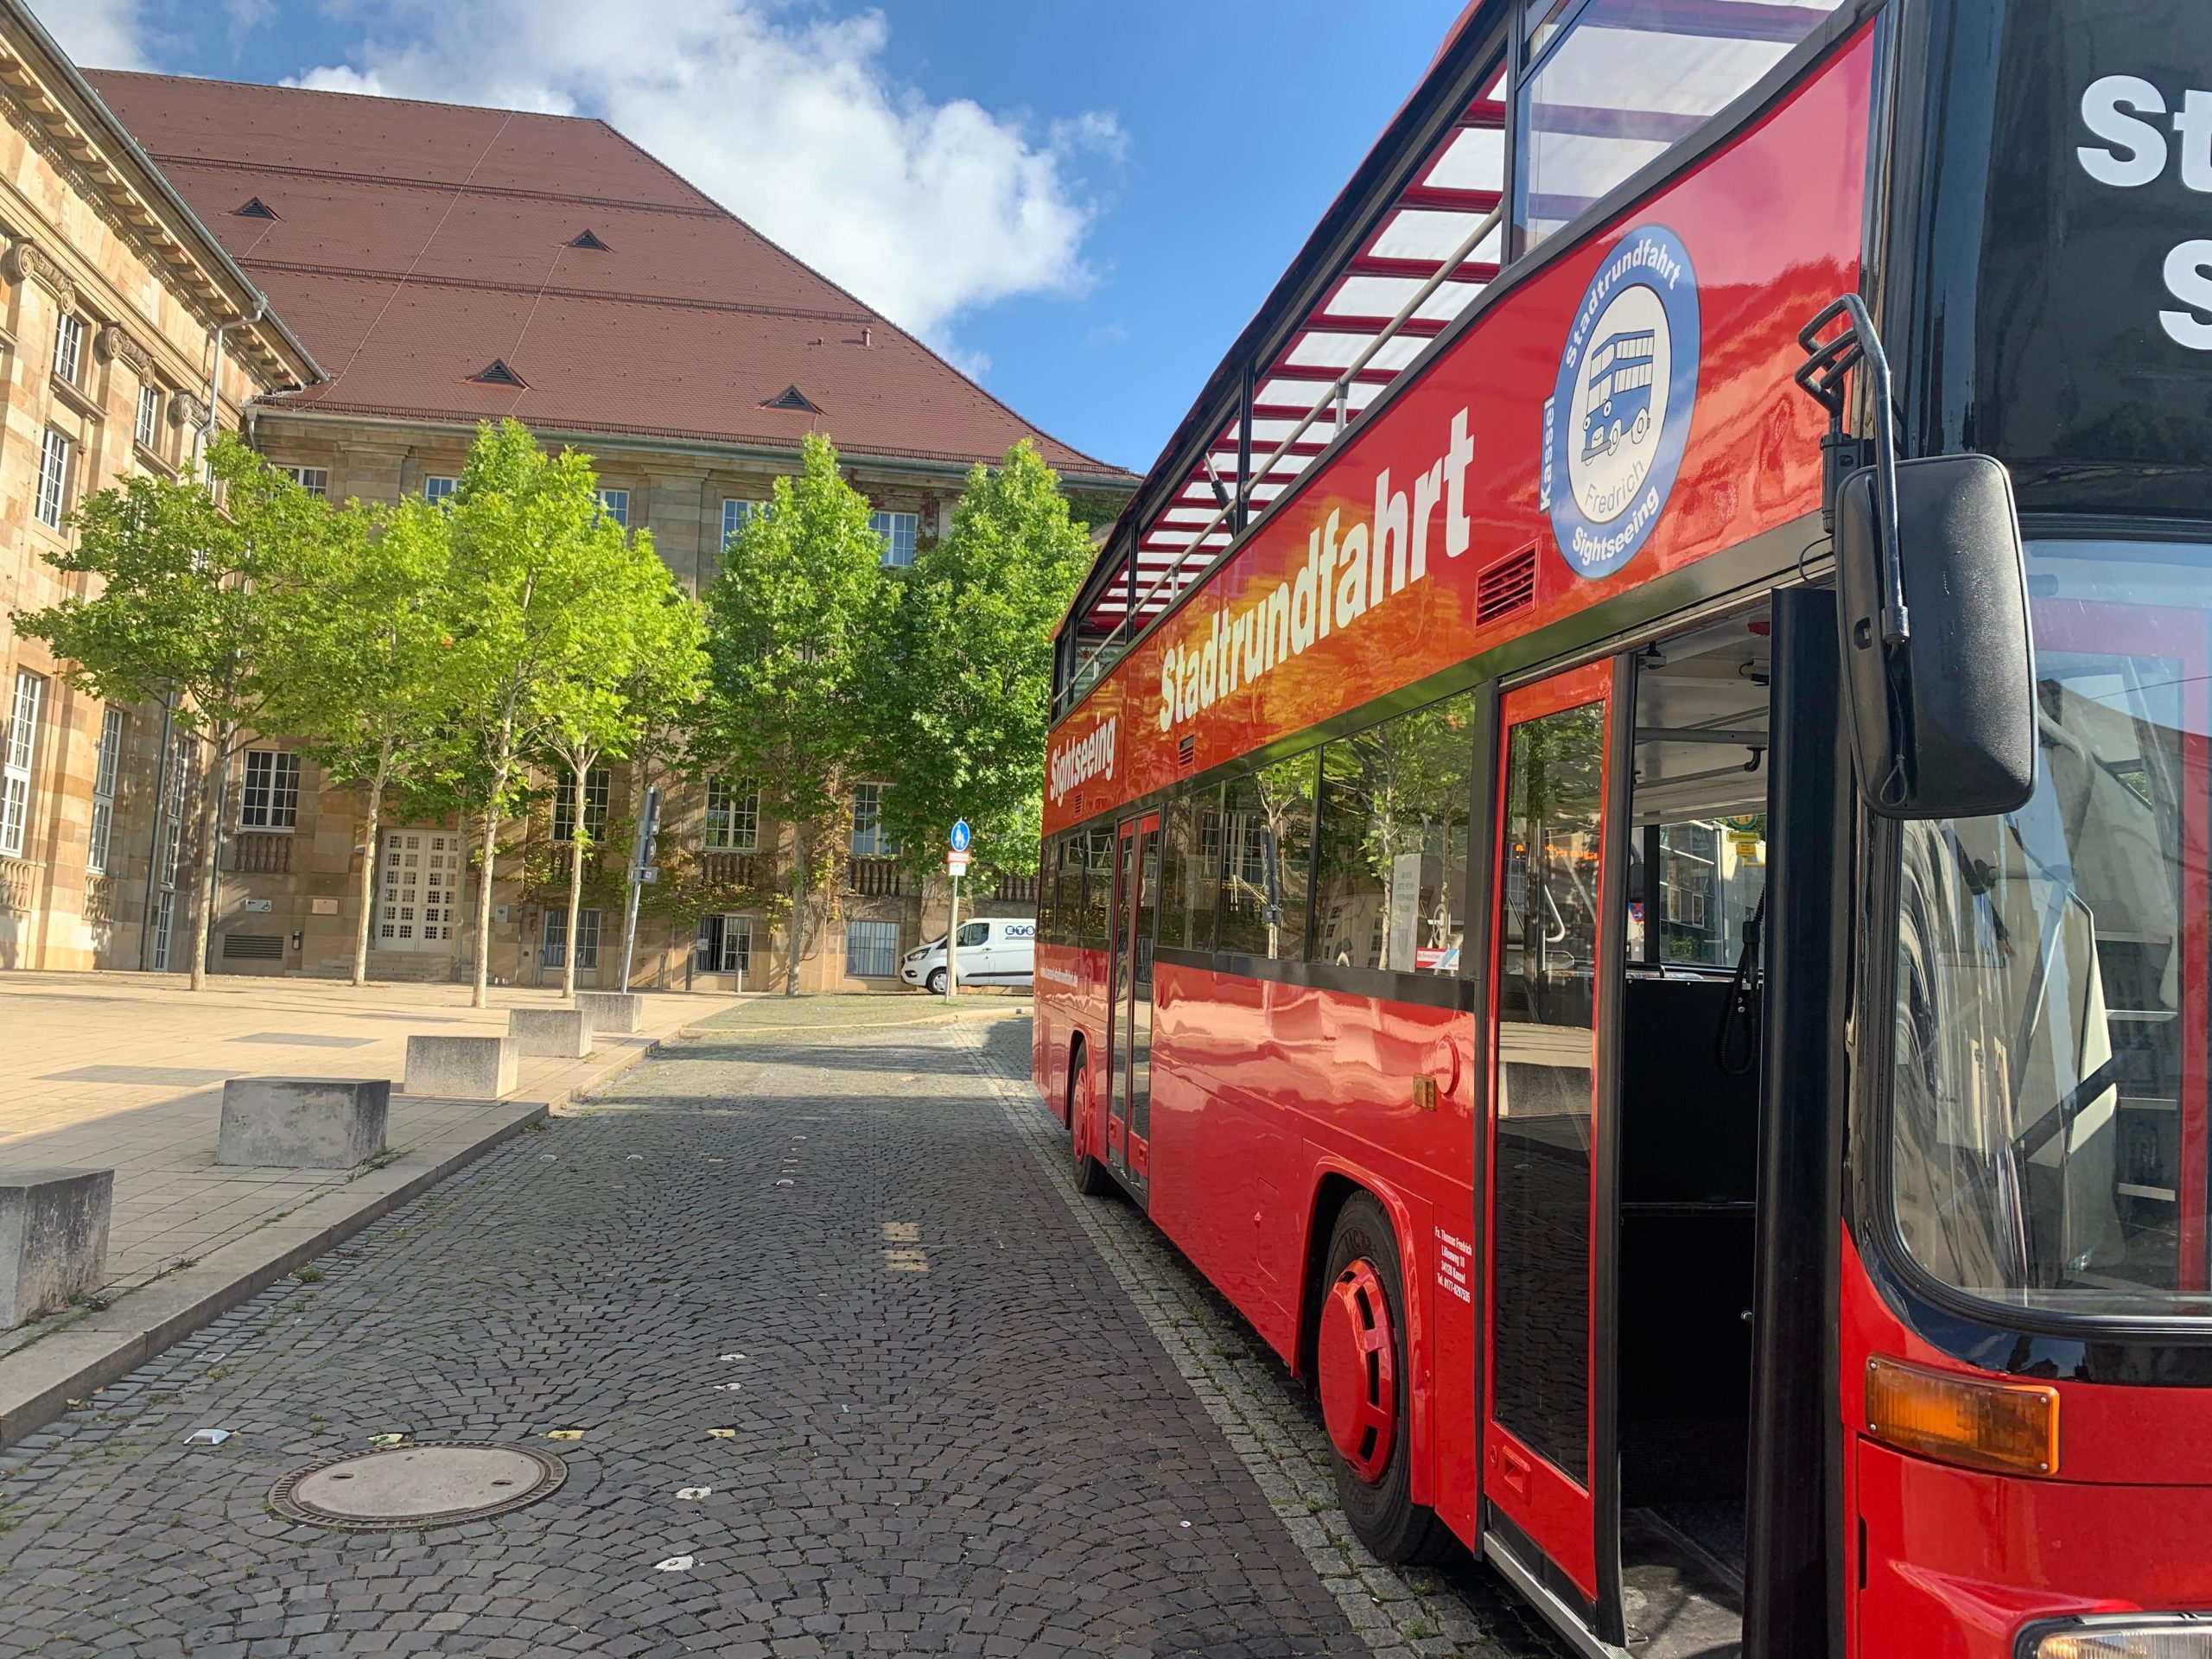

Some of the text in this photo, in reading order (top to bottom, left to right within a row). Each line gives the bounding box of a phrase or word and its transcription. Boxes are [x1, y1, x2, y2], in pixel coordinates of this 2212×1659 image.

[1566, 238, 1681, 370] Stadtrundfahrt
[1539, 397, 1554, 512] Kassel
[1584, 458, 1644, 514] Fredrich
[1160, 406, 1474, 733] Stadtrundfahrt
[1572, 485, 1660, 566] Sightseeing
[1050, 711, 1116, 808] Sightseeing
